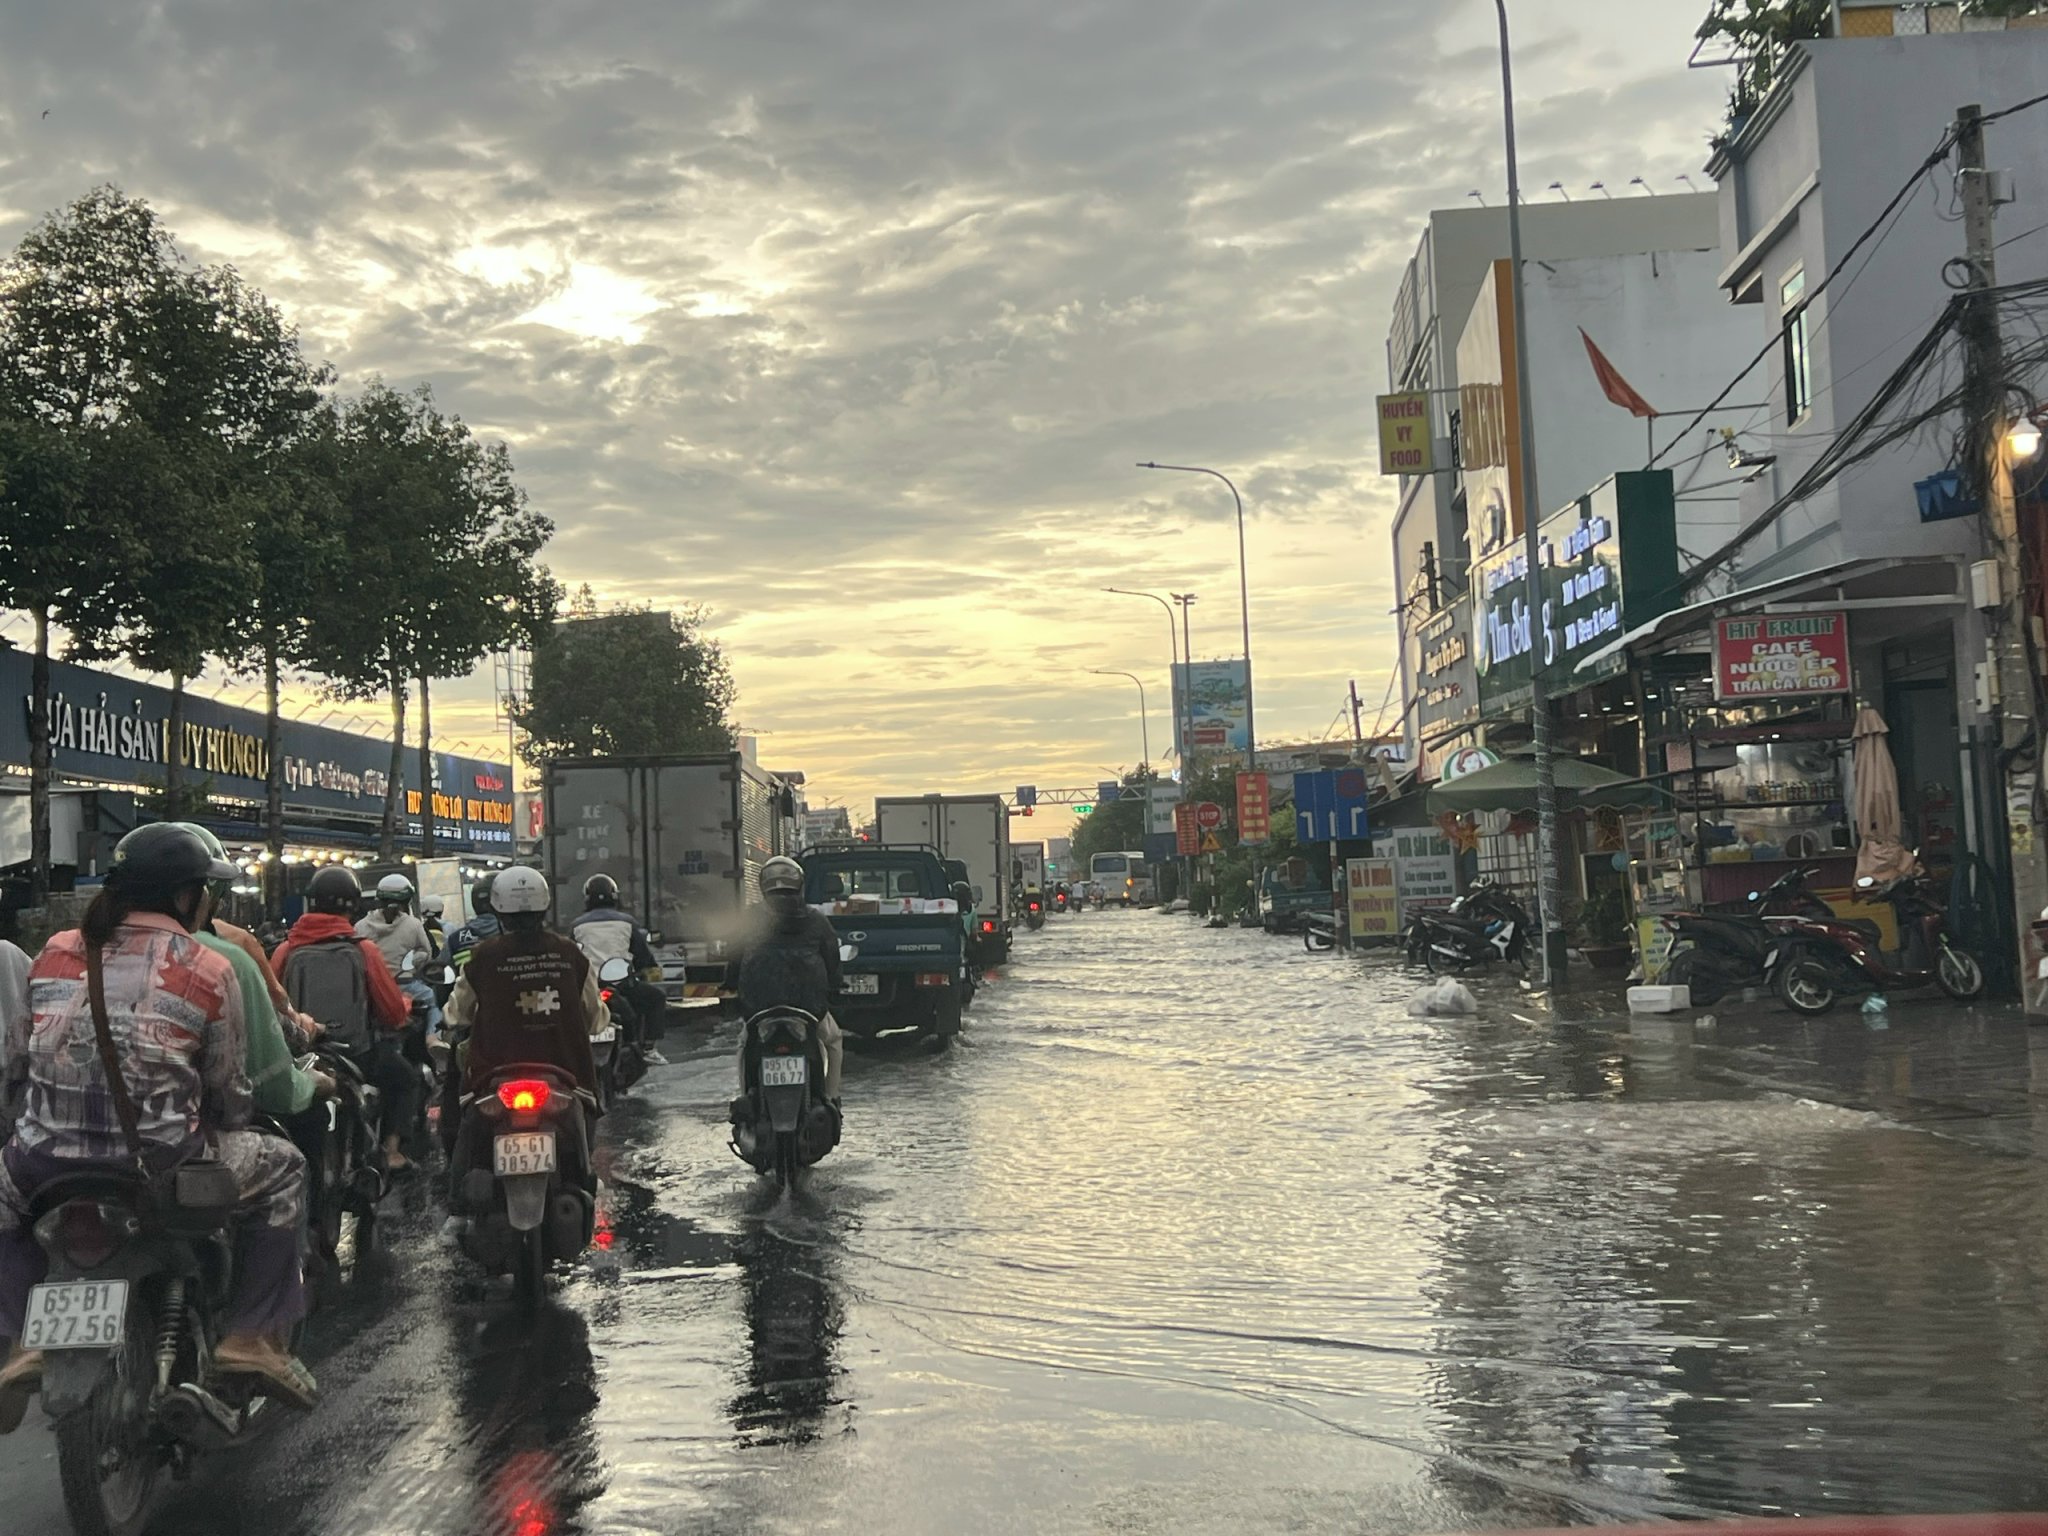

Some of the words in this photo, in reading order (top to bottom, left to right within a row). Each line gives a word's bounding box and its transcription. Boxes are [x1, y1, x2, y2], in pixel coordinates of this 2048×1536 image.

[1390, 449, 1421, 467] FOOD
[1726, 621, 1761, 640] HT
[1767, 616, 1836, 638] FRUIT
[1751, 639, 1813, 655] CAFÉ
[27, 691, 76, 758] ỰA
[80, 692, 117, 756] HẢI
[120, 699, 158, 763] SẢN
[407, 789, 423, 815] HU
[582, 805, 602, 819] XE
[1200, 811, 1219, 820] STOP
